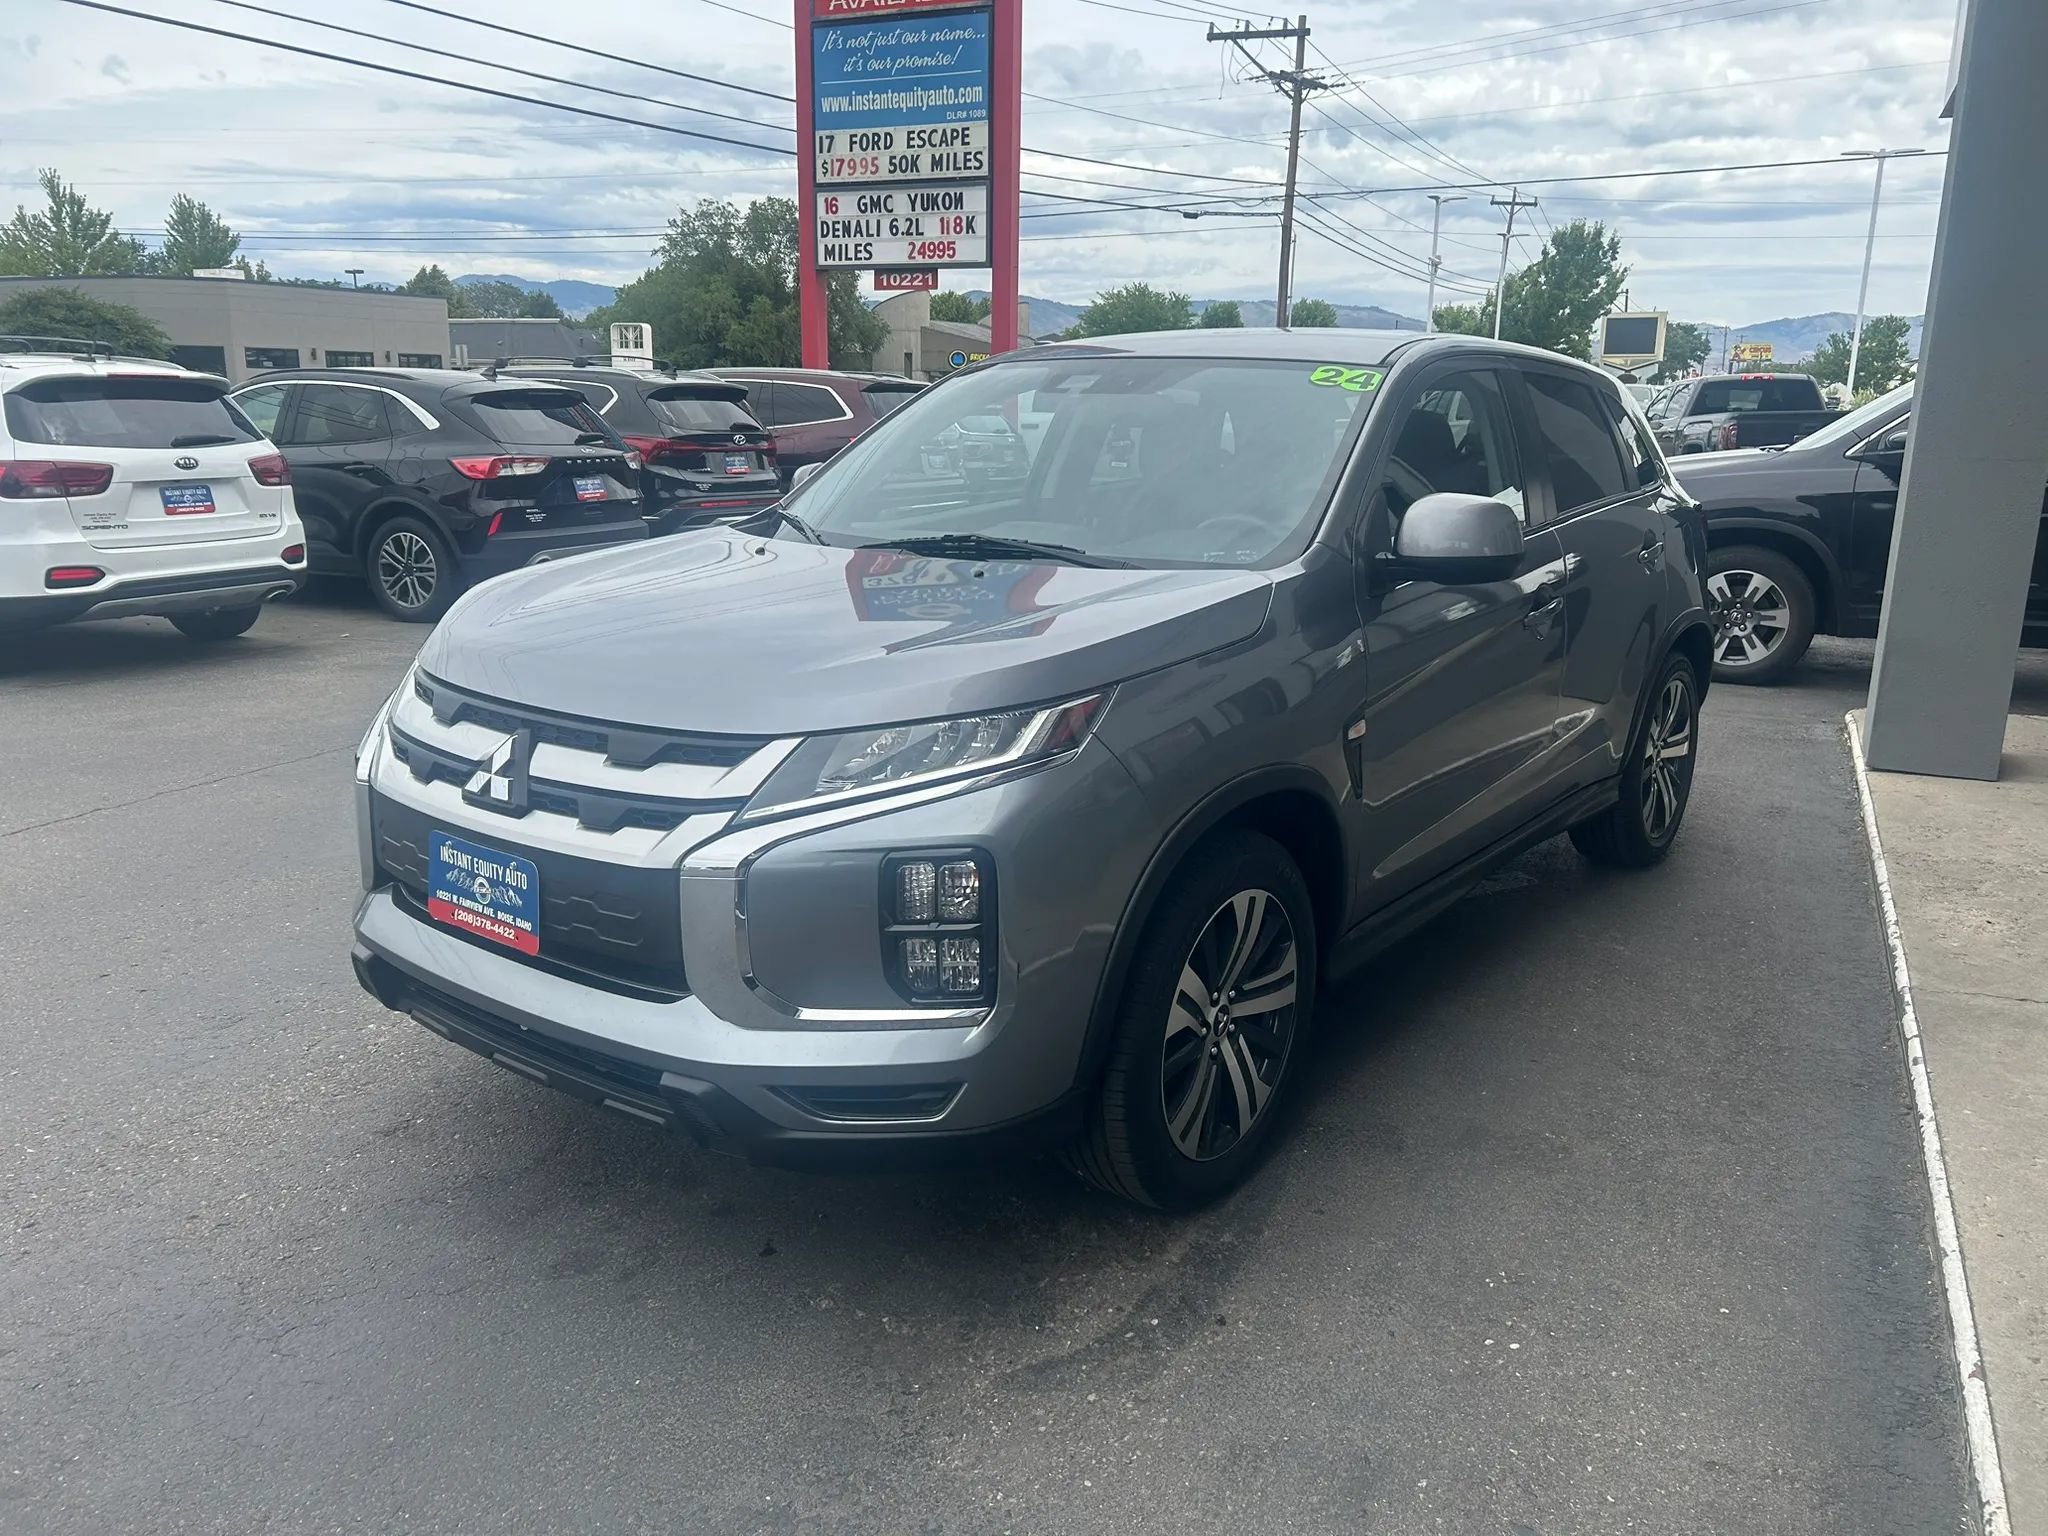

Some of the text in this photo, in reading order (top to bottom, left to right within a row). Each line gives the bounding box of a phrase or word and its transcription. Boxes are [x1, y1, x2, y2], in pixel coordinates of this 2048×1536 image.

[822, 27, 986, 55] It's not just our name...
[843, 44, 963, 76] it's our promise!
[821, 85, 983, 113] www.instantequityauto.com
[818, 127, 971, 154] 17 FORD ESCAPE
[821, 151, 984, 177] $17995 50K MILES
[824, 192, 964, 215] 16 GMC YUKON
[820, 219, 881, 239] DENALI
[889, 217, 924, 236] 6.2L
[824, 241, 957, 262] MILES 24995
[880, 272, 933, 287] 10221
[1312, 367, 1379, 390] 24
[440, 845, 527, 890] INSTANT EQUITY AUTO
[454, 908, 515, 940] (208)378-4422
[516, 917, 532, 932] IDAHO
